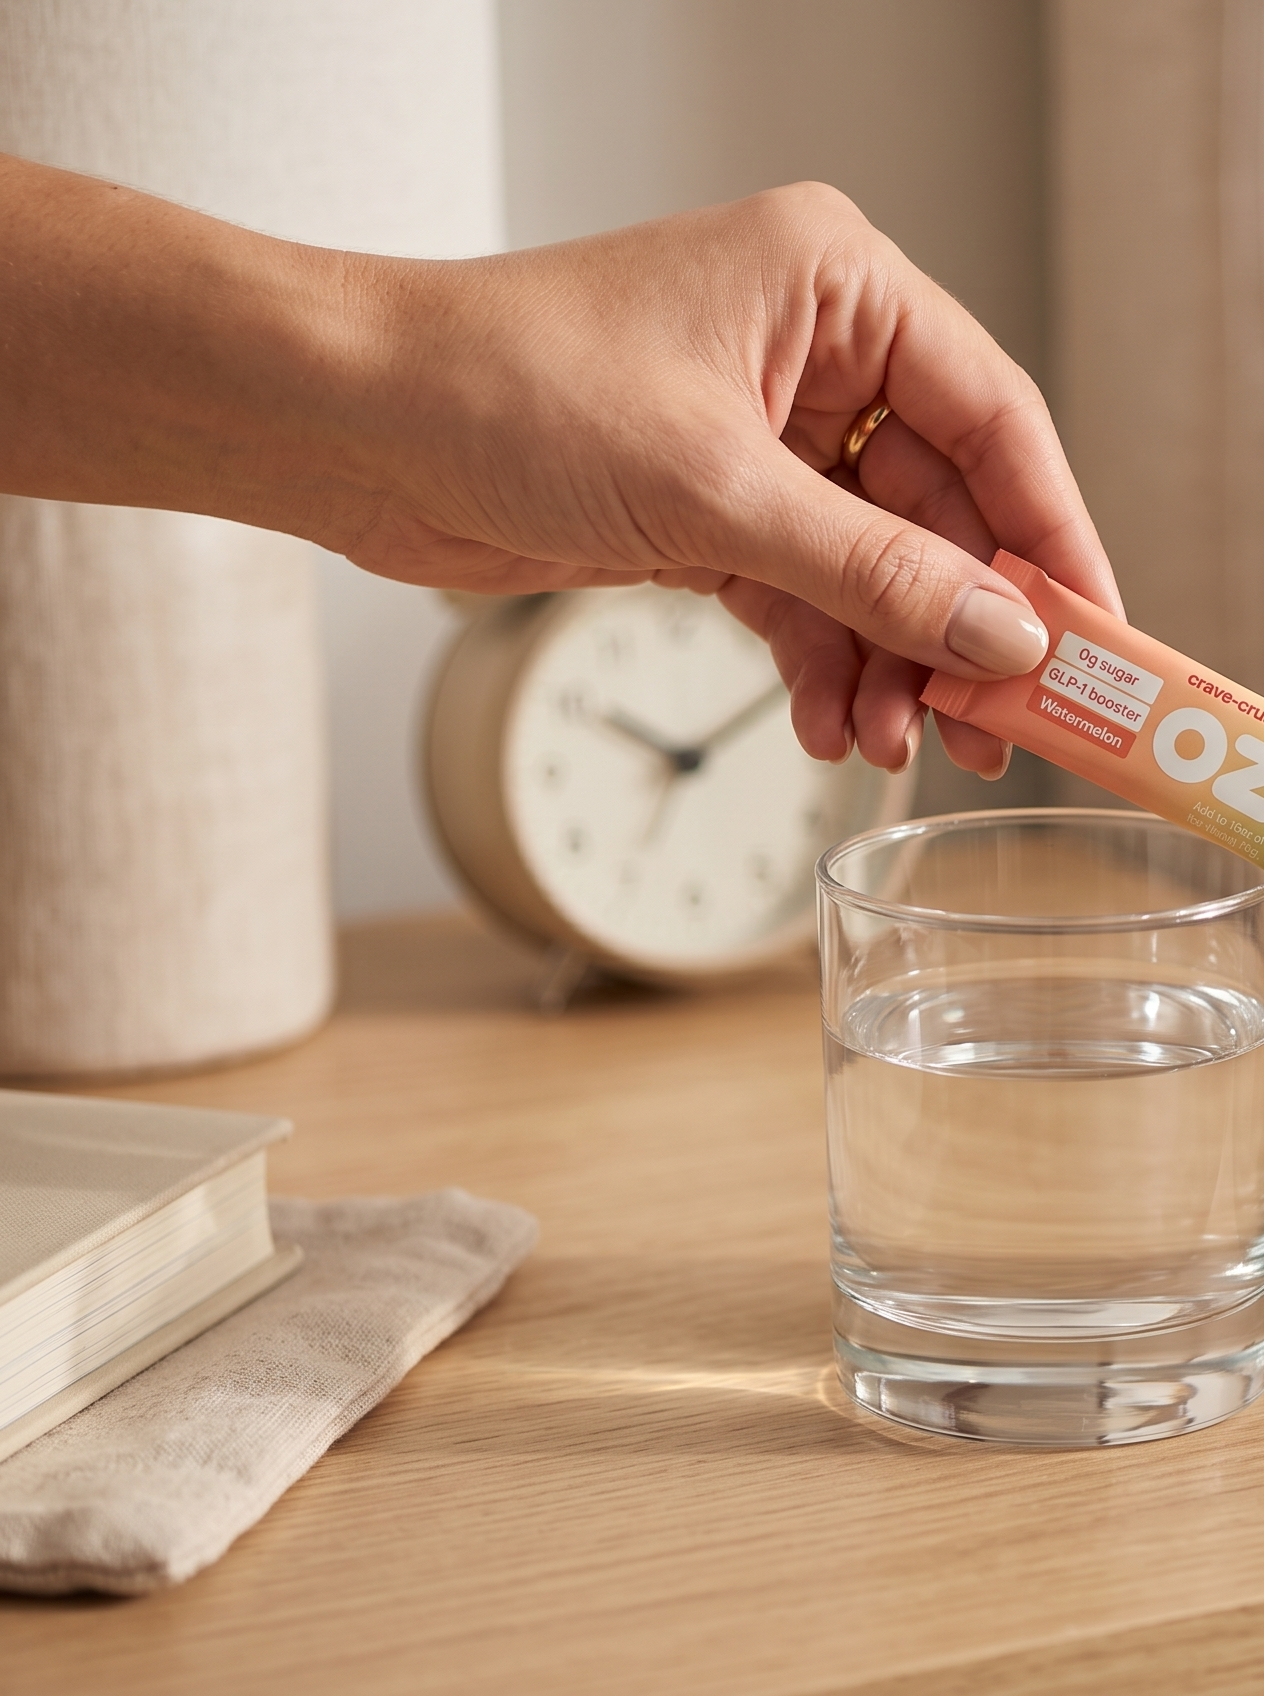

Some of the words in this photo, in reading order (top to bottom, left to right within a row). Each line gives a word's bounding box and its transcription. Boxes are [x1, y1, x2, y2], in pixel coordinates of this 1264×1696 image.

[1079, 648, 1098, 669] 0g
[1099, 660, 1140, 686] sugar
[1048, 667, 1088, 695] GLP-1
[1088, 687, 1141, 722] booster
[1040, 695, 1122, 748] Watermelon
[1193, 801, 1216, 819] Add
